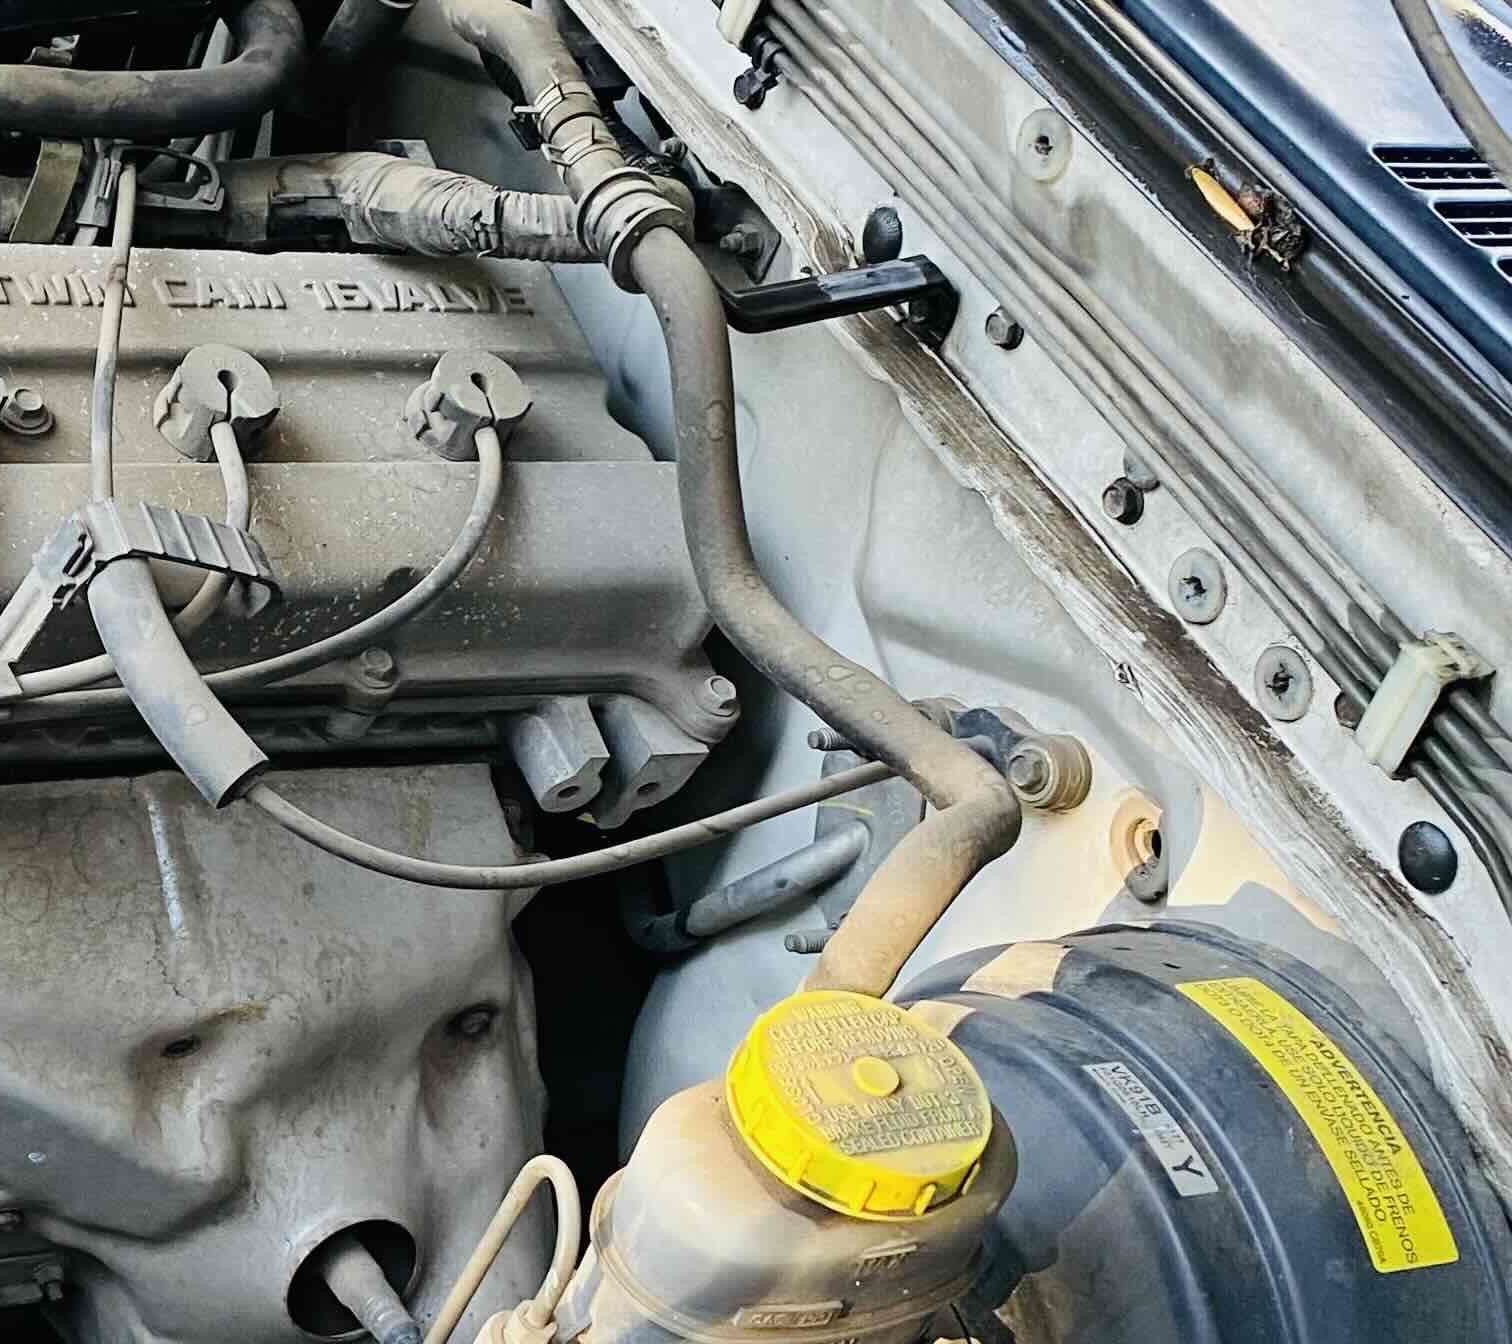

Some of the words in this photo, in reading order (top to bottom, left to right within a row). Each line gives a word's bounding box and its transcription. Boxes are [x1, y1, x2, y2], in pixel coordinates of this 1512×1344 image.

[156, 278, 287, 311] CAM
[824, 1105, 858, 1122] USE
[864, 1096, 905, 1115] ONLY
[1309, 1039, 1402, 1155] ADVERTENCIA
[839, 1132, 901, 1155] SEALED
[900, 1120, 983, 1147] CONTAINER
[1171, 1155, 1205, 1178] Y
[1288, 1068, 1311, 1088] UN
[1303, 1090, 1349, 1146] ENVASE
[1343, 1149, 1387, 1223] SELLADO
[1302, 1065, 1337, 1103] SOLO
[1370, 1170, 1388, 1194] DE
[1383, 1195, 1419, 1265] FRENOS
[1322, 1071, 1373, 1136] LLENADO
[1397, 1192, 1416, 1216] DE
